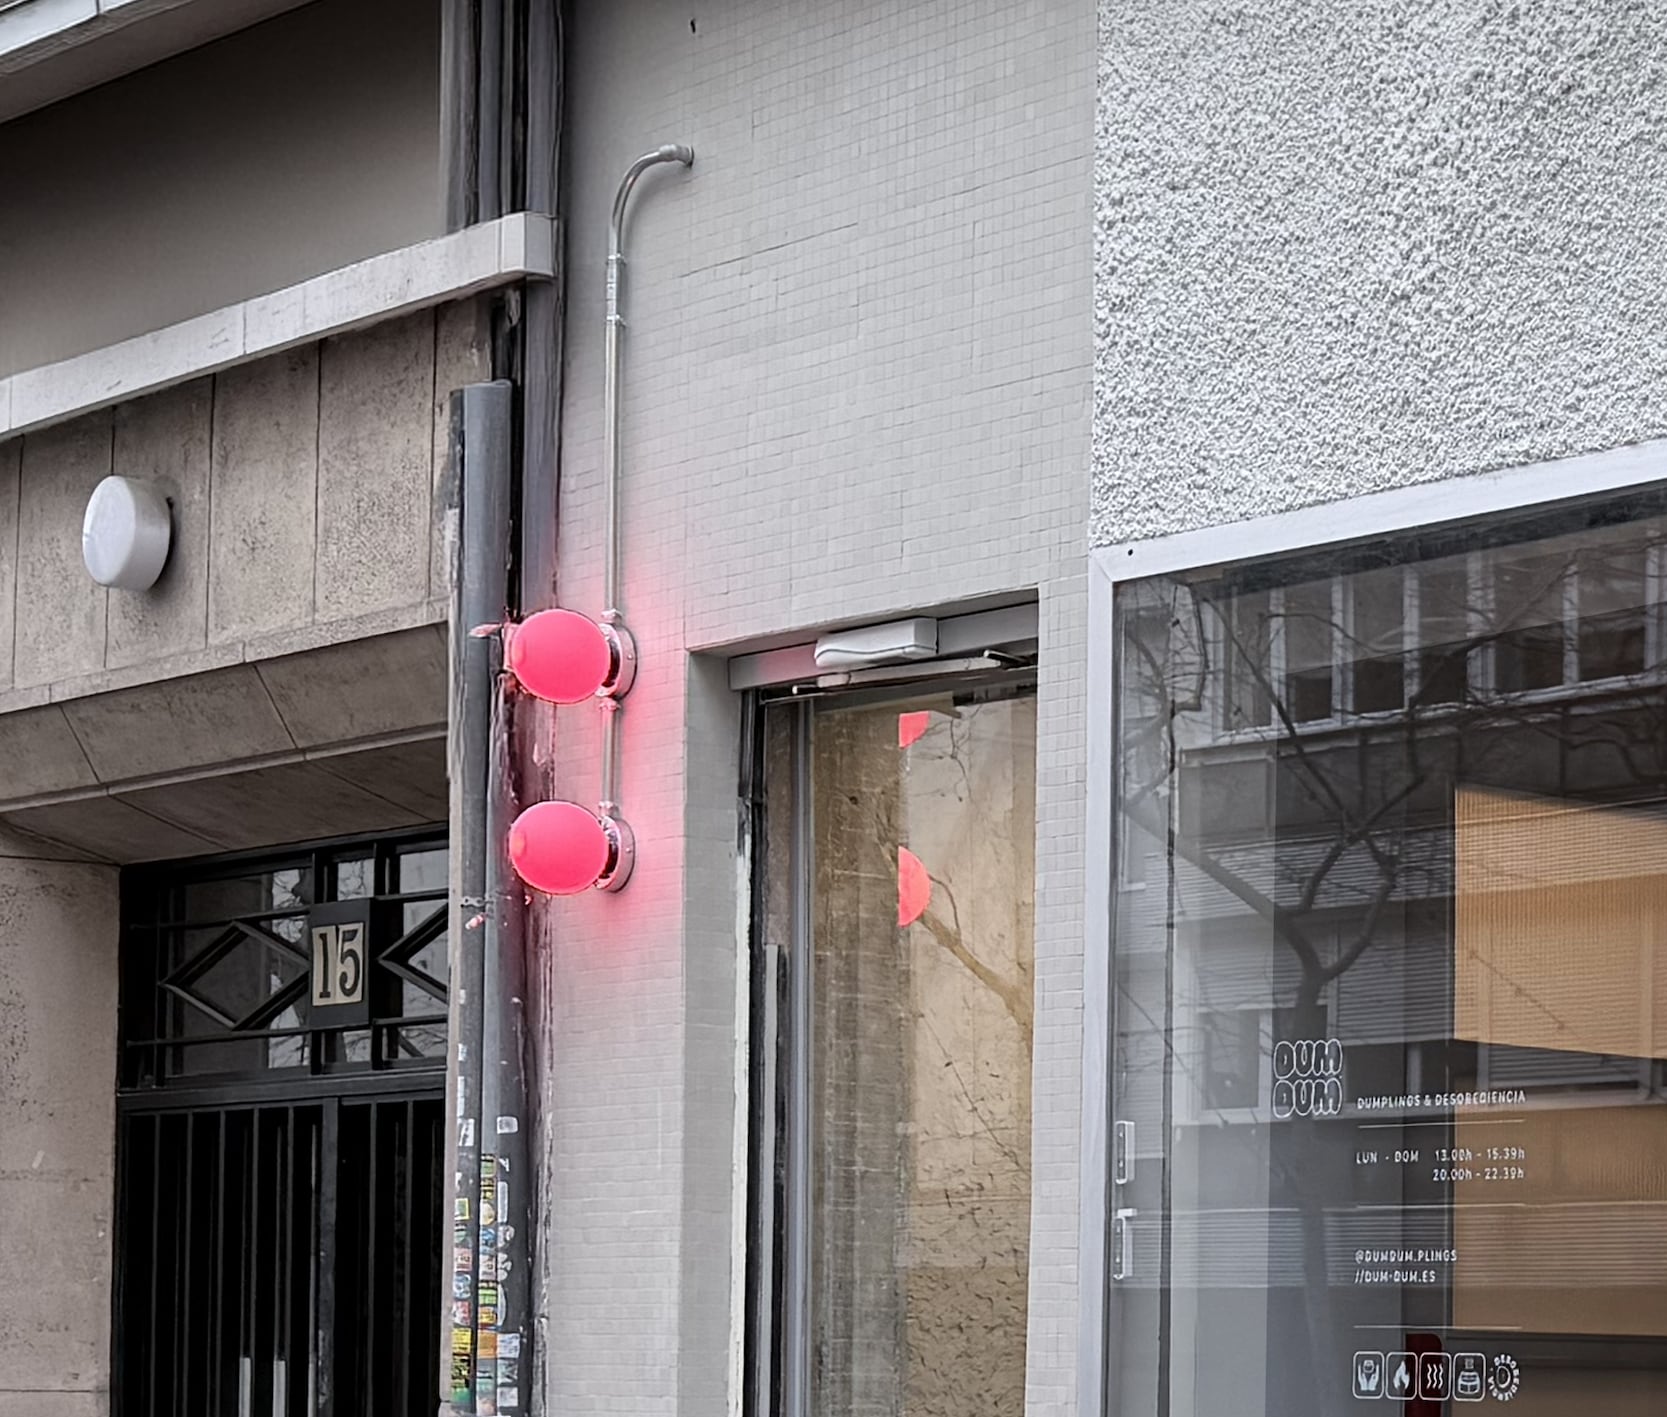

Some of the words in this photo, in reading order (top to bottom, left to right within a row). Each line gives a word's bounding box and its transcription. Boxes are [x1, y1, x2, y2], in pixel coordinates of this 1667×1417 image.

[319, 928, 360, 998] 15
[1273, 1038, 1343, 1080] DUM
[1272, 1077, 1342, 1119] DUM
[1357, 1094, 1421, 1110] DUMPLINGS
[1423, 1095, 1432, 1107] &
[1435, 1090, 1526, 1106] DESOBEDIENCIA
[1356, 1151, 1378, 1164] LUN
[1394, 1150, 1419, 1163] DOM
